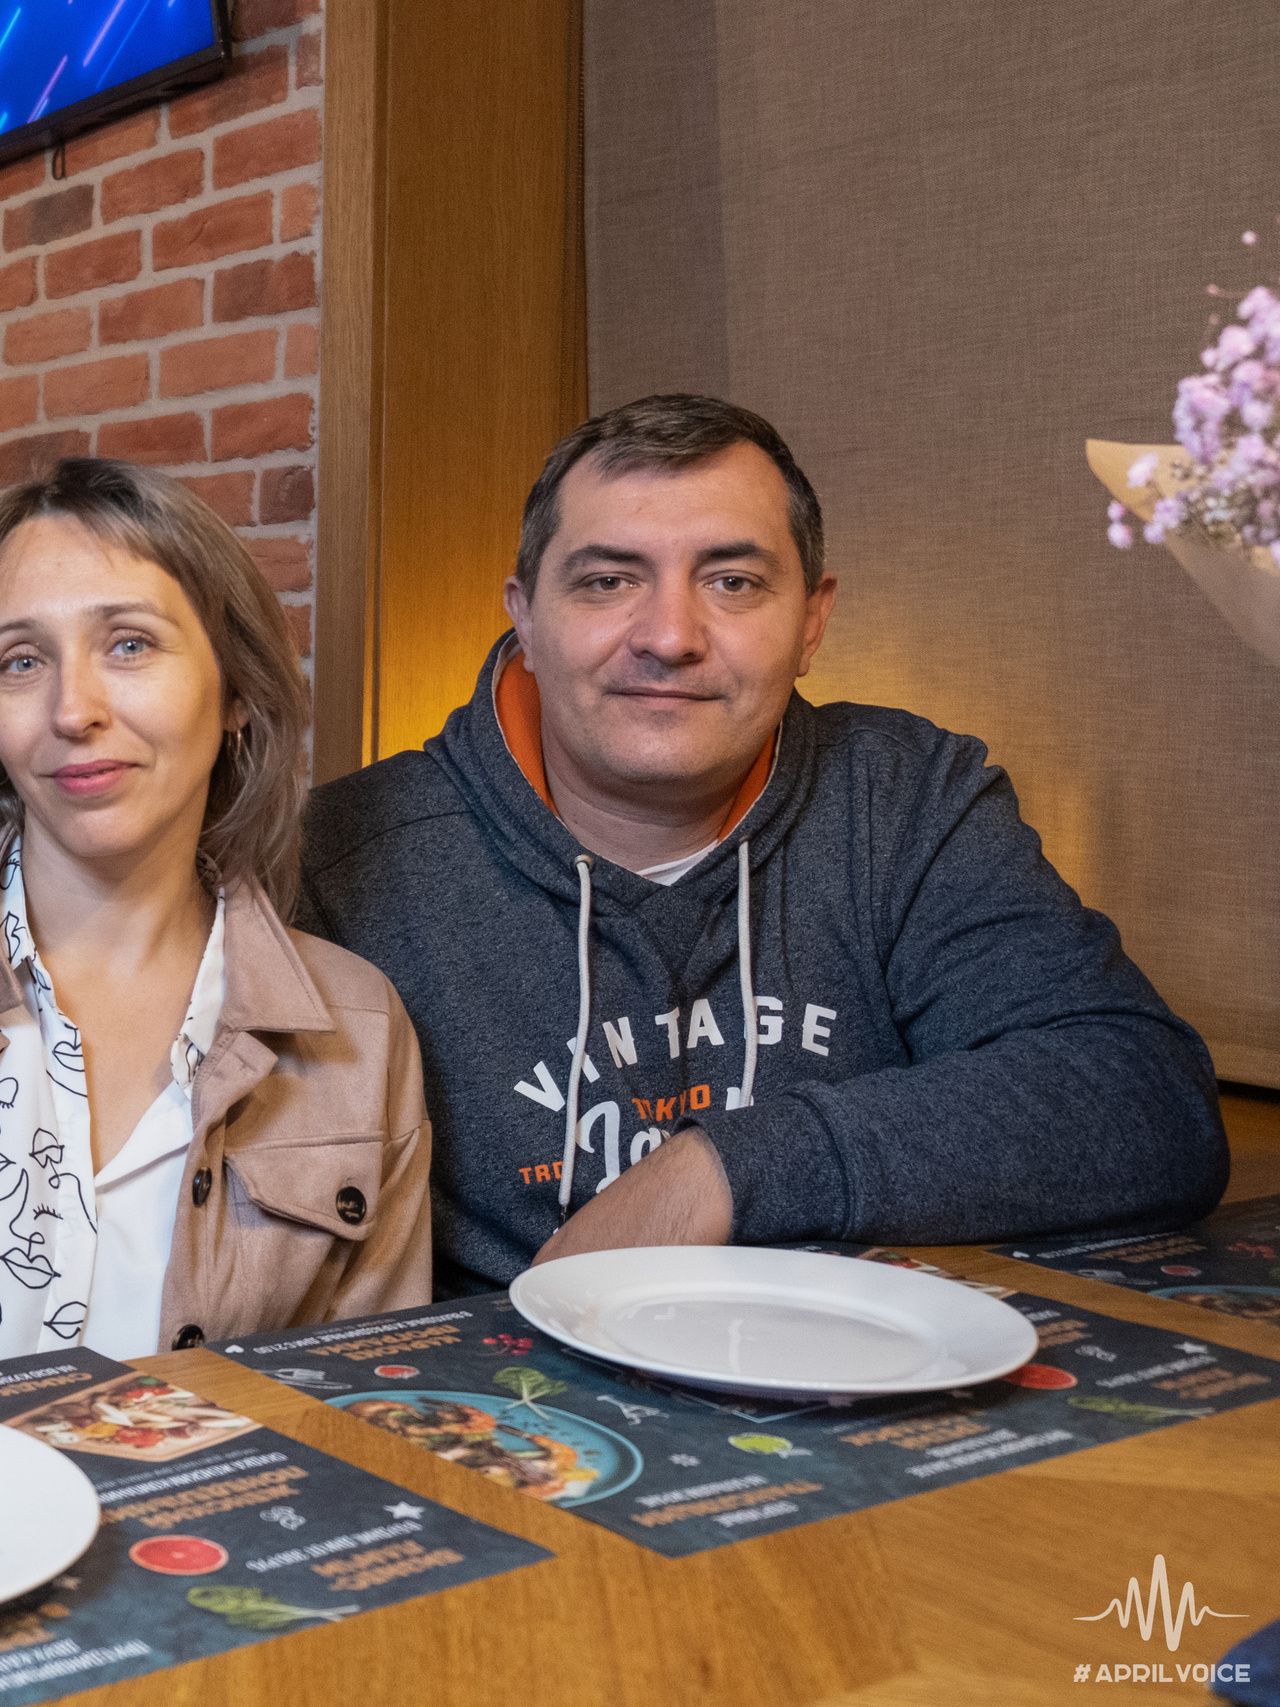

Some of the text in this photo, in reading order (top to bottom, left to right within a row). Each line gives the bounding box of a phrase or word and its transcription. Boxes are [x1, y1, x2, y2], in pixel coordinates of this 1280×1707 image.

[513, 995, 838, 1112] VINTAGE
[307, 1325, 458, 1355] ПРОГРАММА
[100, 1466, 307, 1523] ПОНЕДЕЛЬНИ
